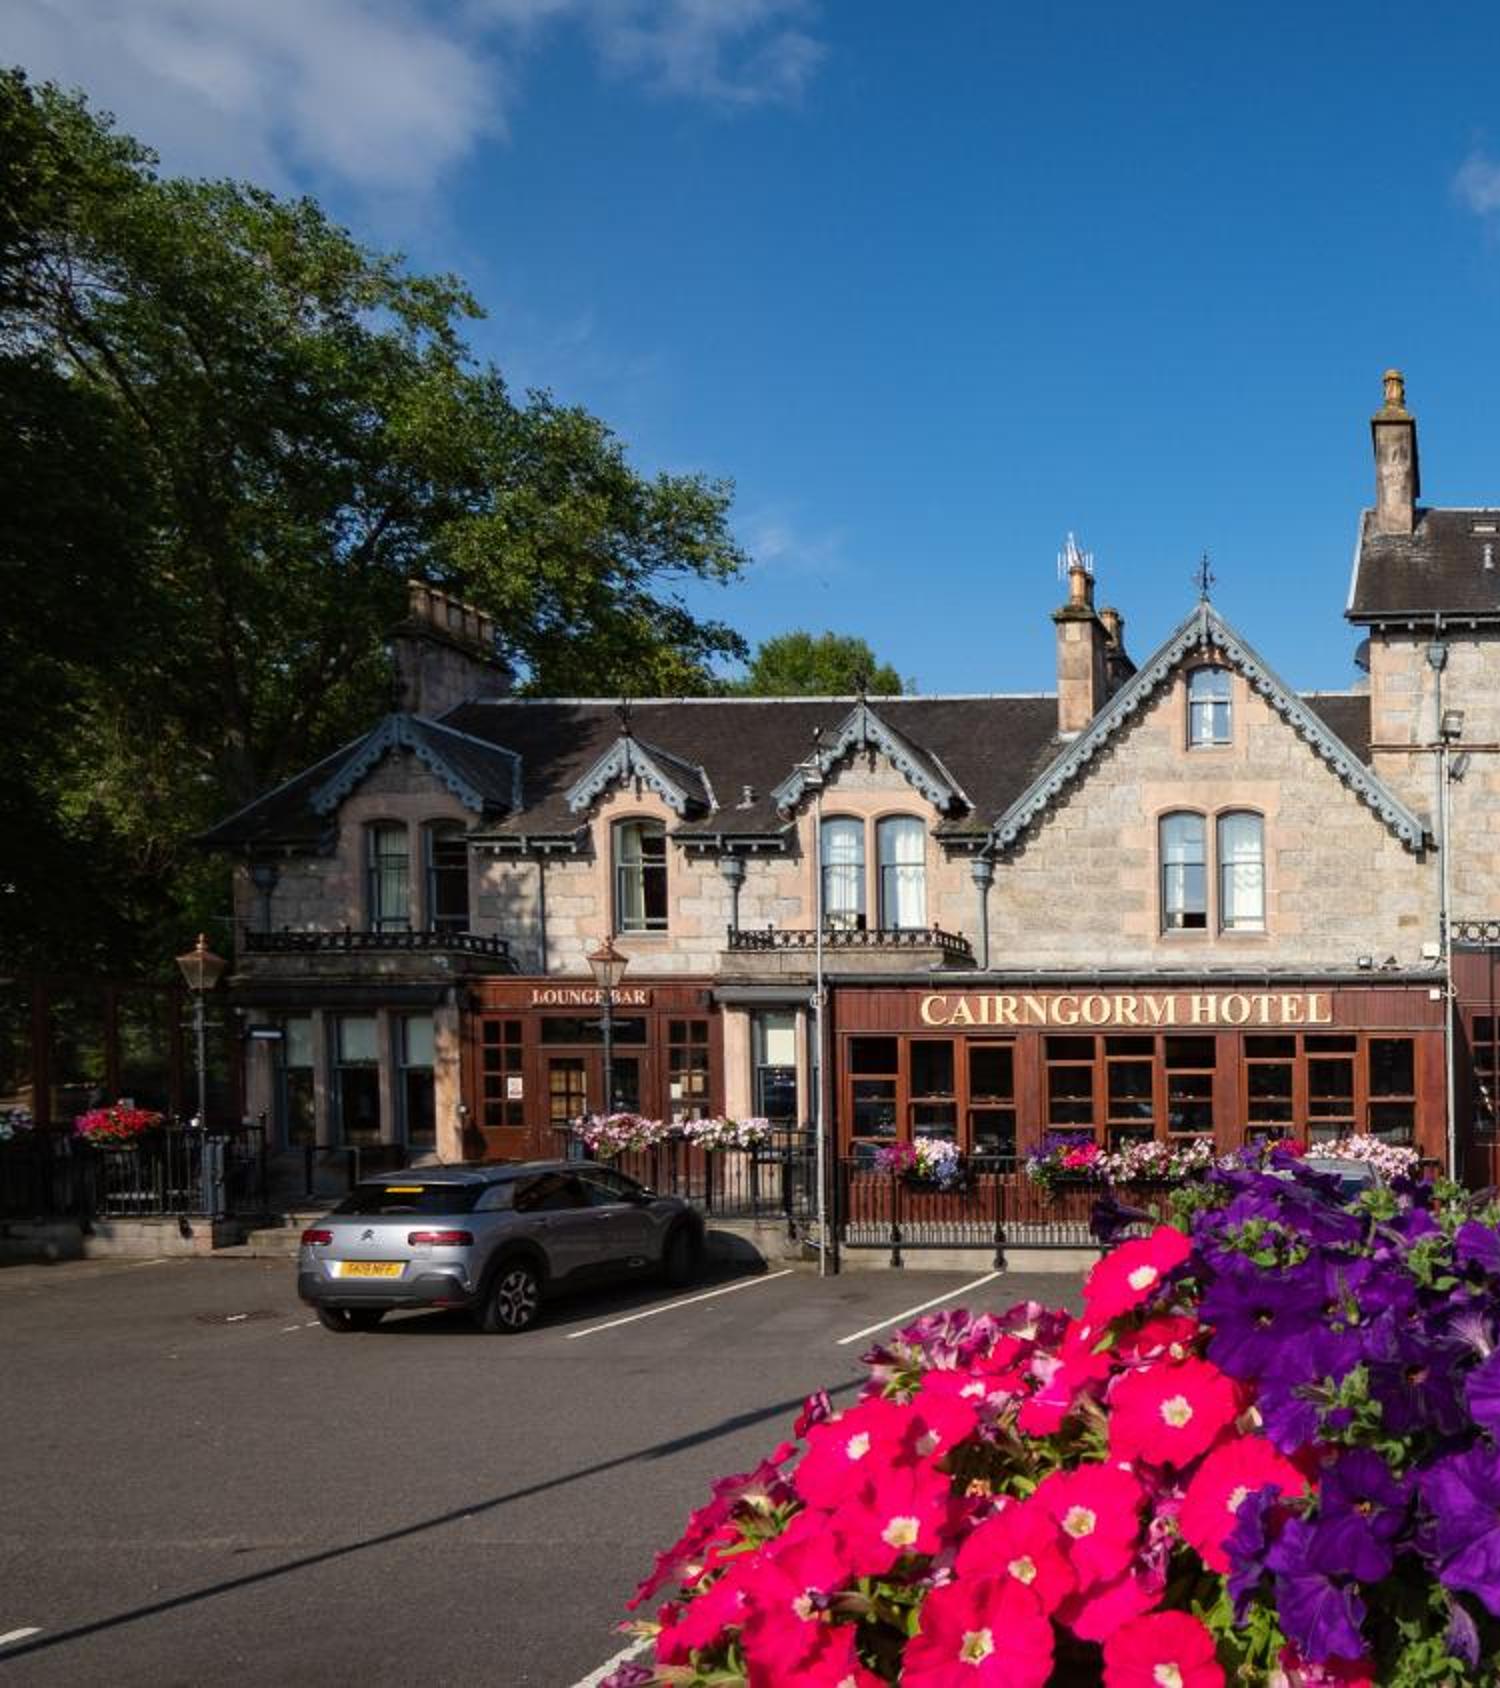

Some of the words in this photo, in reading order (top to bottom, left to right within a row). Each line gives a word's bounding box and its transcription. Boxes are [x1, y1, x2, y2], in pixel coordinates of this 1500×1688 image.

[532, 988, 606, 1005] LOUNGE
[611, 988, 646, 1005] BAR
[920, 994, 1176, 1025] CAIRNGORM
[1191, 993, 1333, 1024] HOTEL
